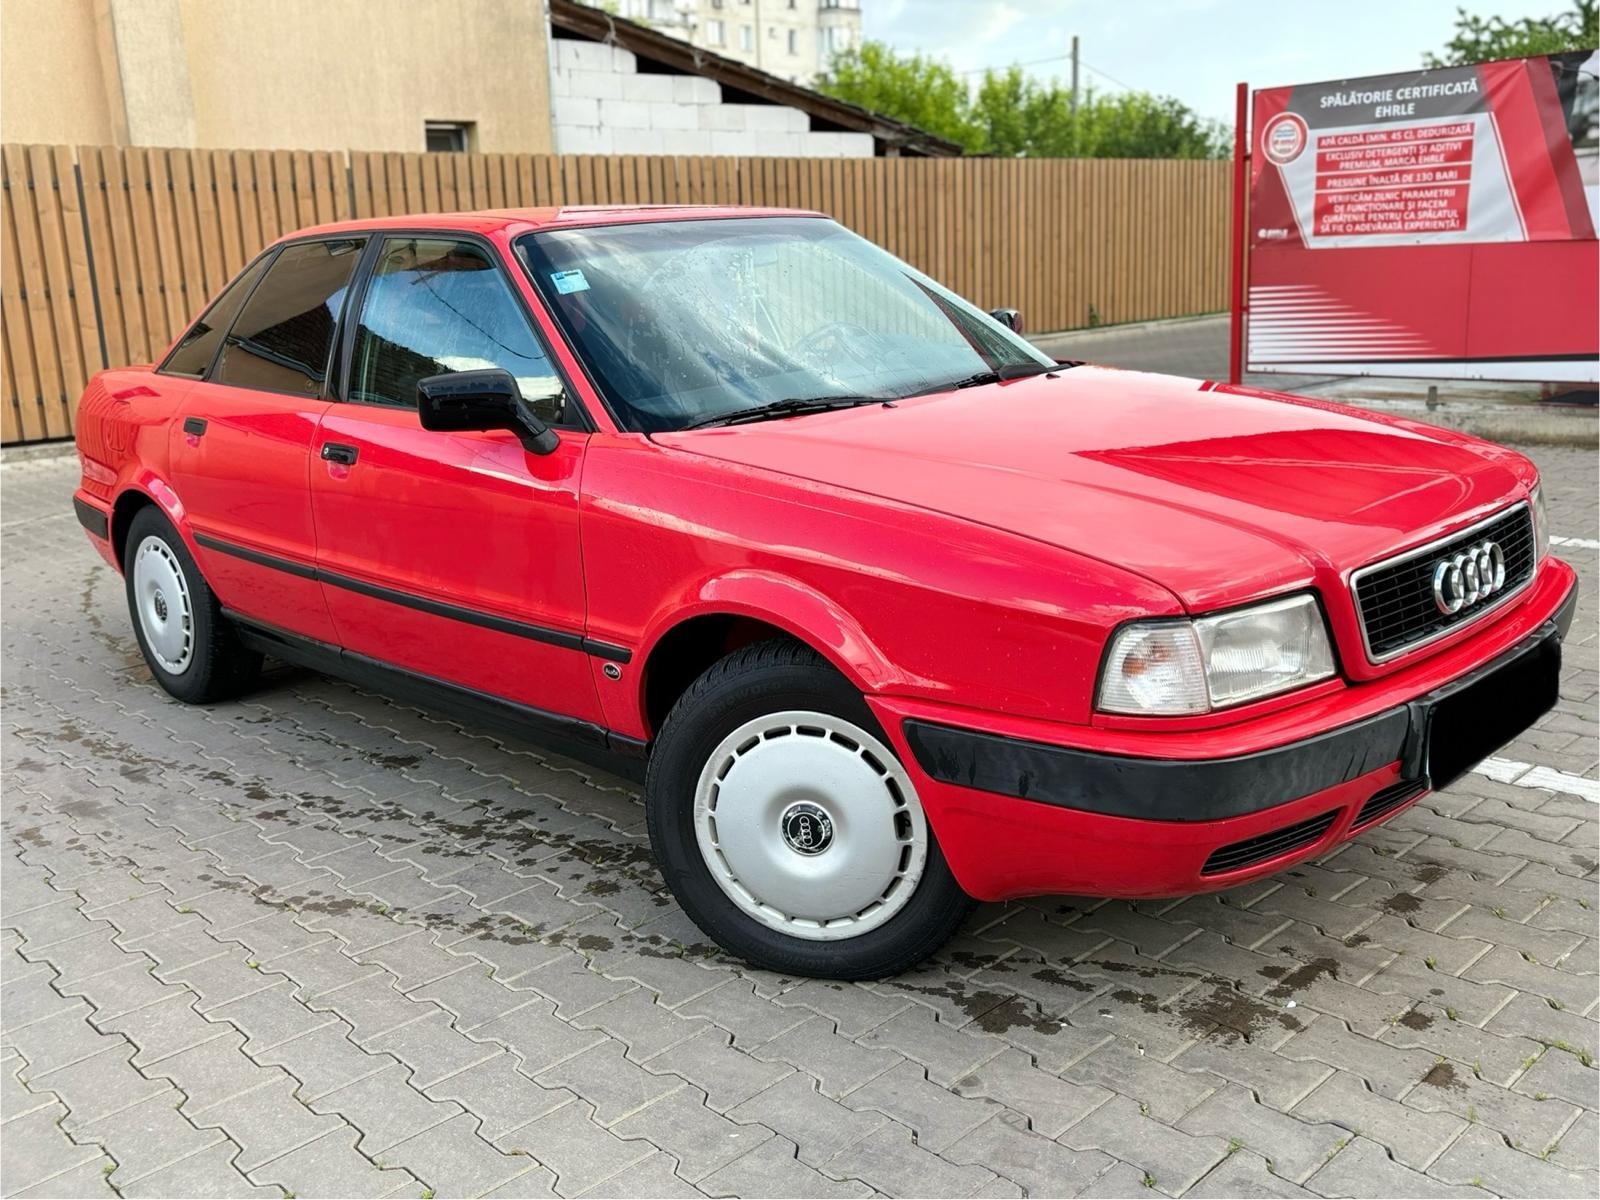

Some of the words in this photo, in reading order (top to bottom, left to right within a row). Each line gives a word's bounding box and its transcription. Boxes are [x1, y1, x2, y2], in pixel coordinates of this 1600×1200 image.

[1320, 89, 1392, 108] SPĂLĂTORIE
[1396, 78, 1478, 100] CERTIFICATĂ
[1375, 103, 1415, 118] EHRLE
[1391, 131, 1401, 140] 45
[1326, 150, 1364, 162] EXCLUSIV
[1429, 142, 1462, 152] ADITIVI
[1384, 156, 1416, 167] MARCA
[1418, 153, 1445, 164] EHRLE
[1327, 176, 1367, 187] PRESIUNE
[1402, 174, 1413, 183] DE
[1416, 172, 1433, 182] 130
[1435, 171, 1458, 180] BARI
[1417, 199, 1448, 209] FACEM
[1367, 211, 1401, 221] PENTRU
[1403, 211, 1416, 220] CA
[1345, 223, 1353, 232] O
